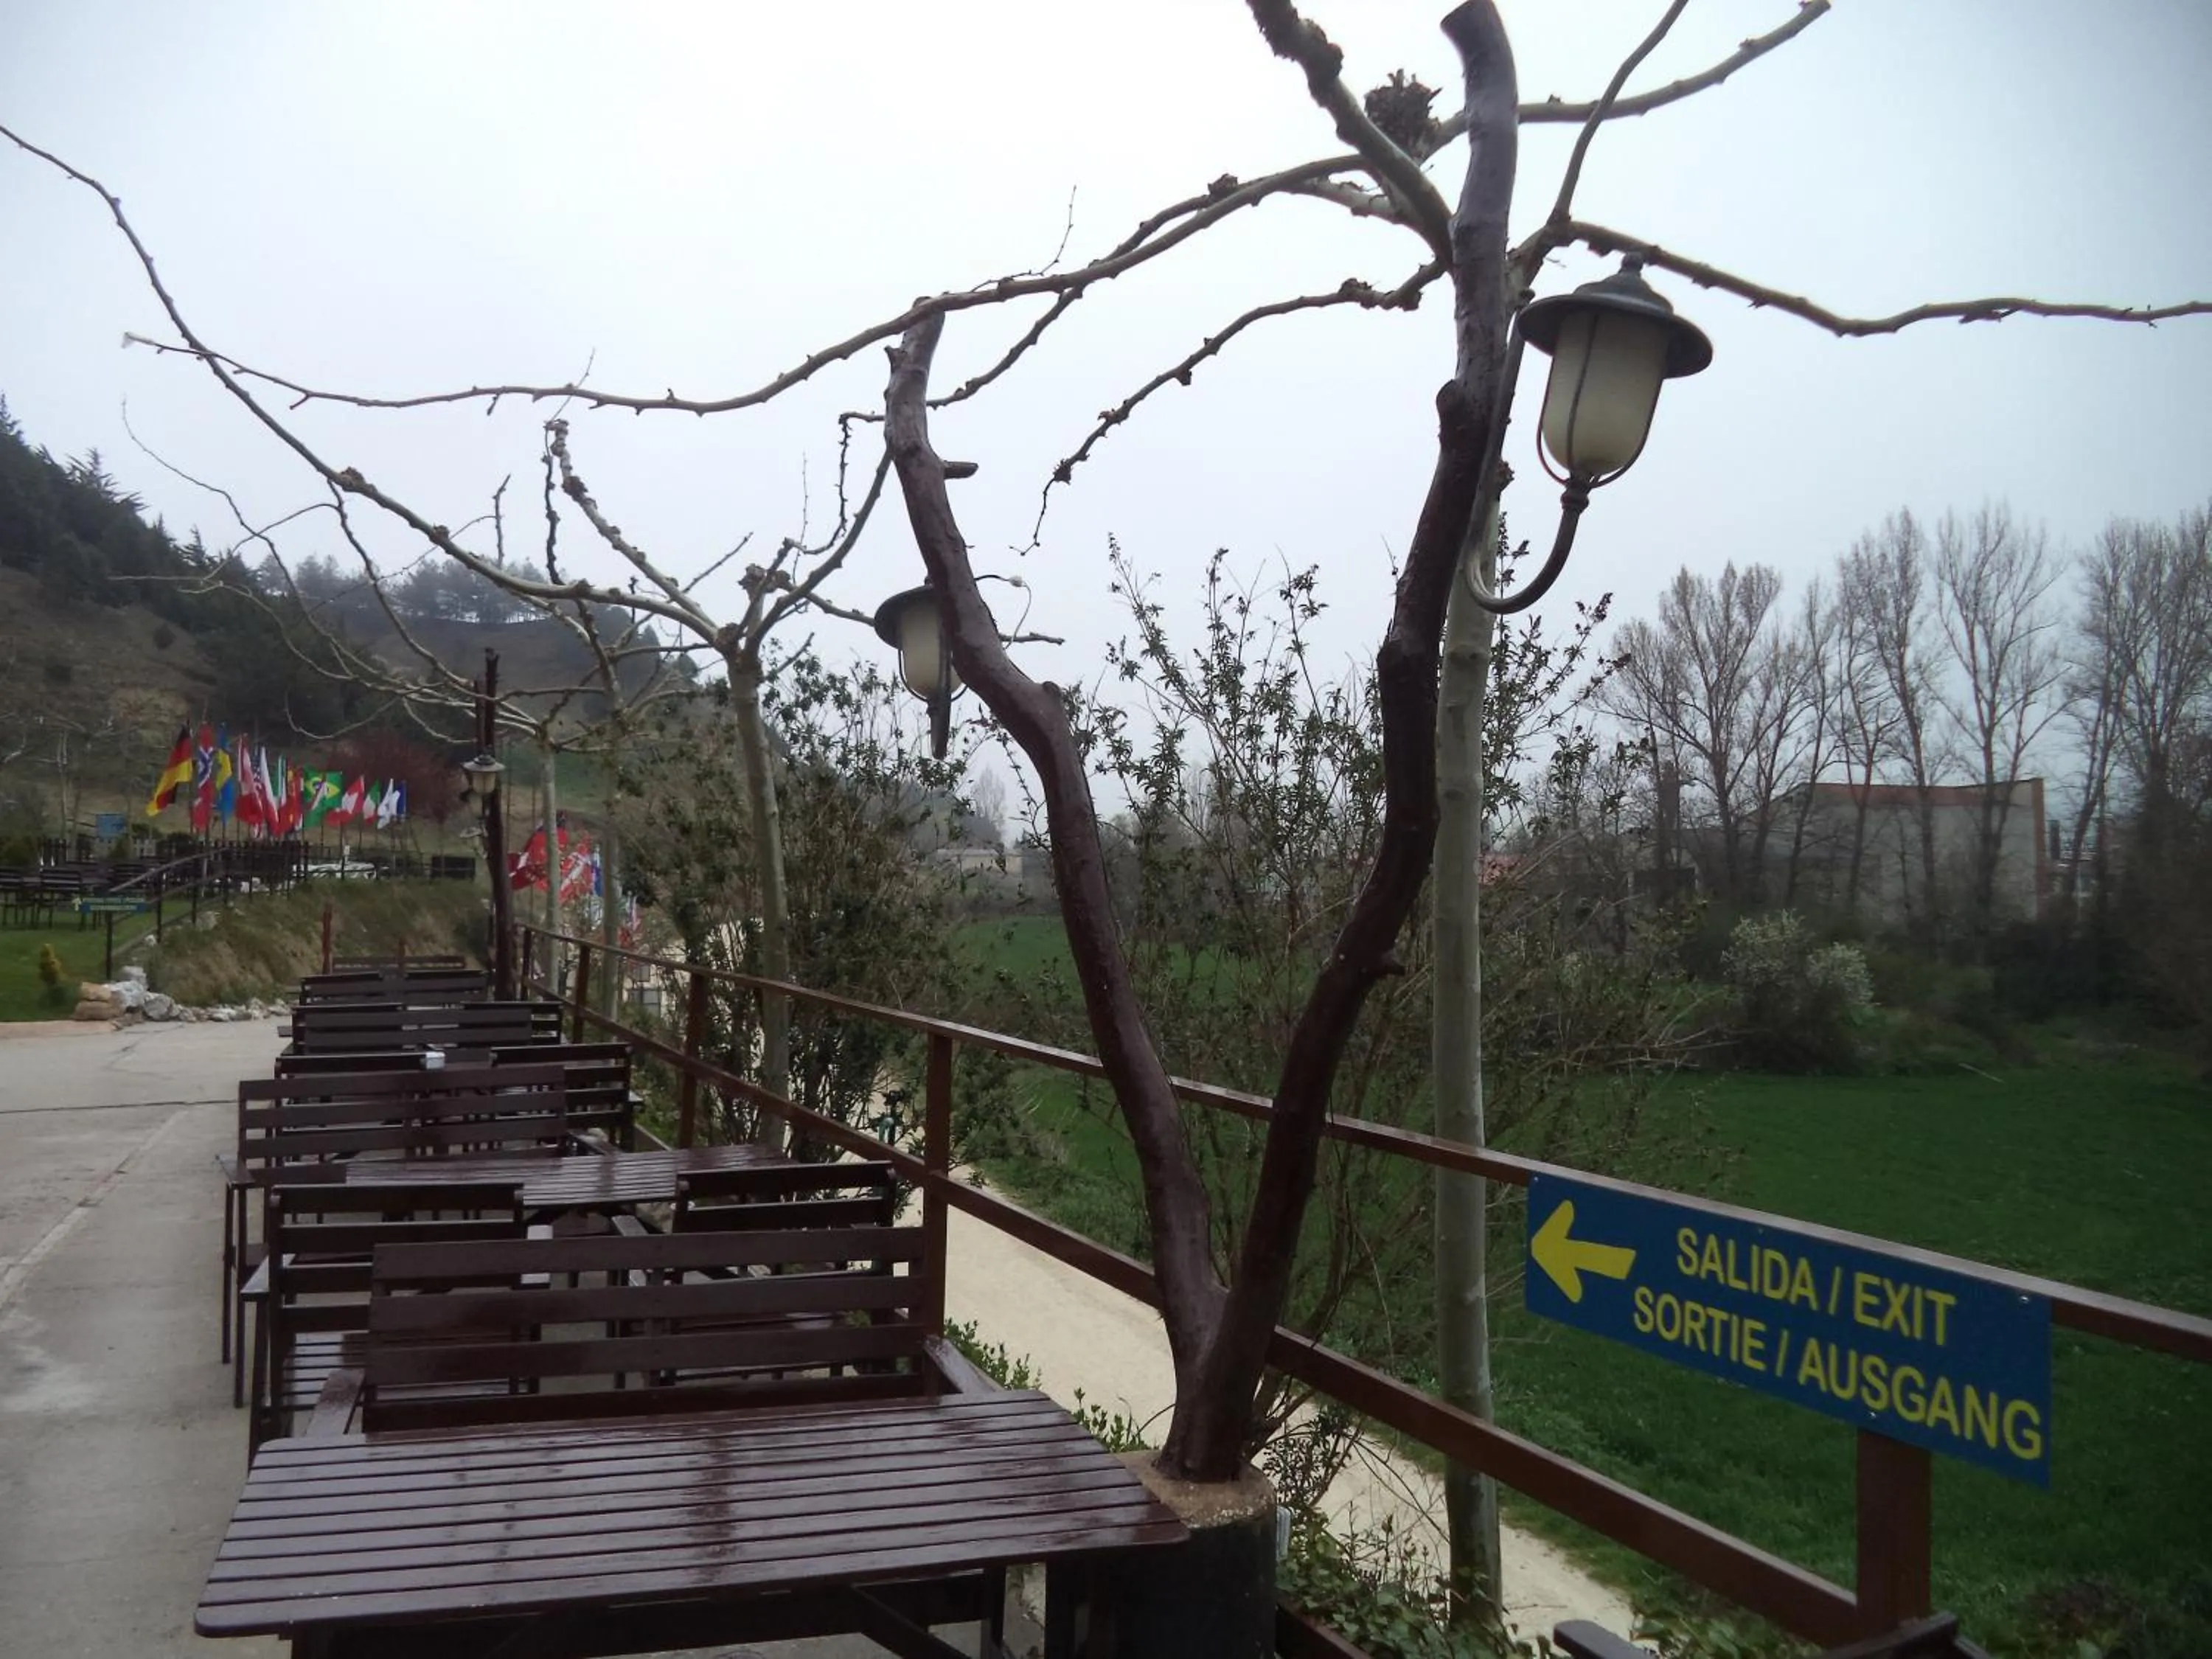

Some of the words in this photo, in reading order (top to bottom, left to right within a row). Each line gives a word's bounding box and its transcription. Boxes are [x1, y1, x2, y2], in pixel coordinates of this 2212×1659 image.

[1677, 1227, 1818, 1311] SALIDA
[1854, 1272, 1956, 1346] EXIT
[1633, 1286, 1767, 1371] SORTIE
[1798, 1338, 2042, 1460] AUSGANG
